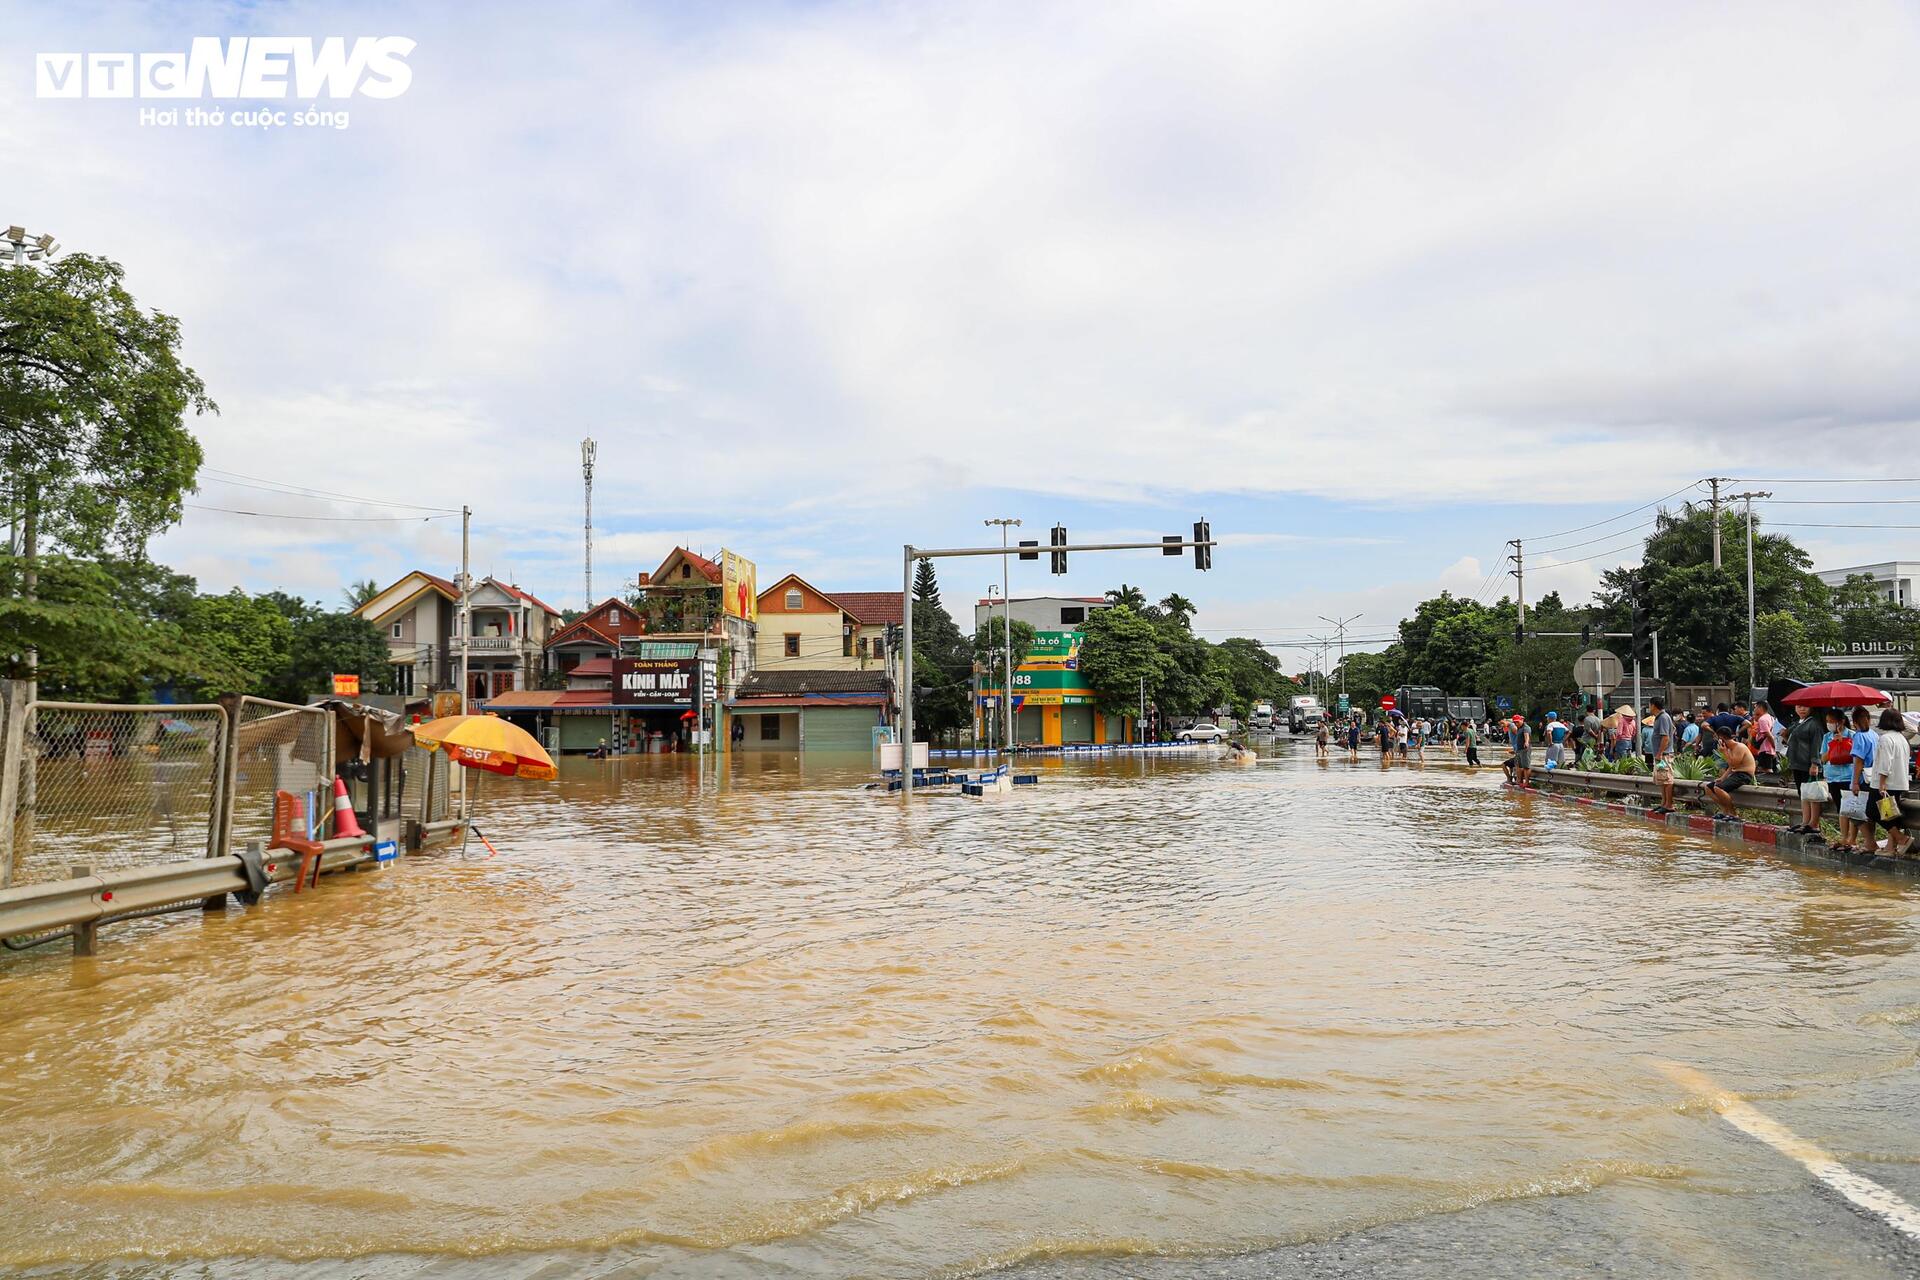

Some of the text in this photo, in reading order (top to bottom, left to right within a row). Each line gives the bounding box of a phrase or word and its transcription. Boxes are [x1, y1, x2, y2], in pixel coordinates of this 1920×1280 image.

[1048, 637, 1060, 645] có
[1851, 641, 1914, 653] BUILDIN
[622, 671, 656, 690] KÍNH
[659, 669, 690, 689] MẮT
